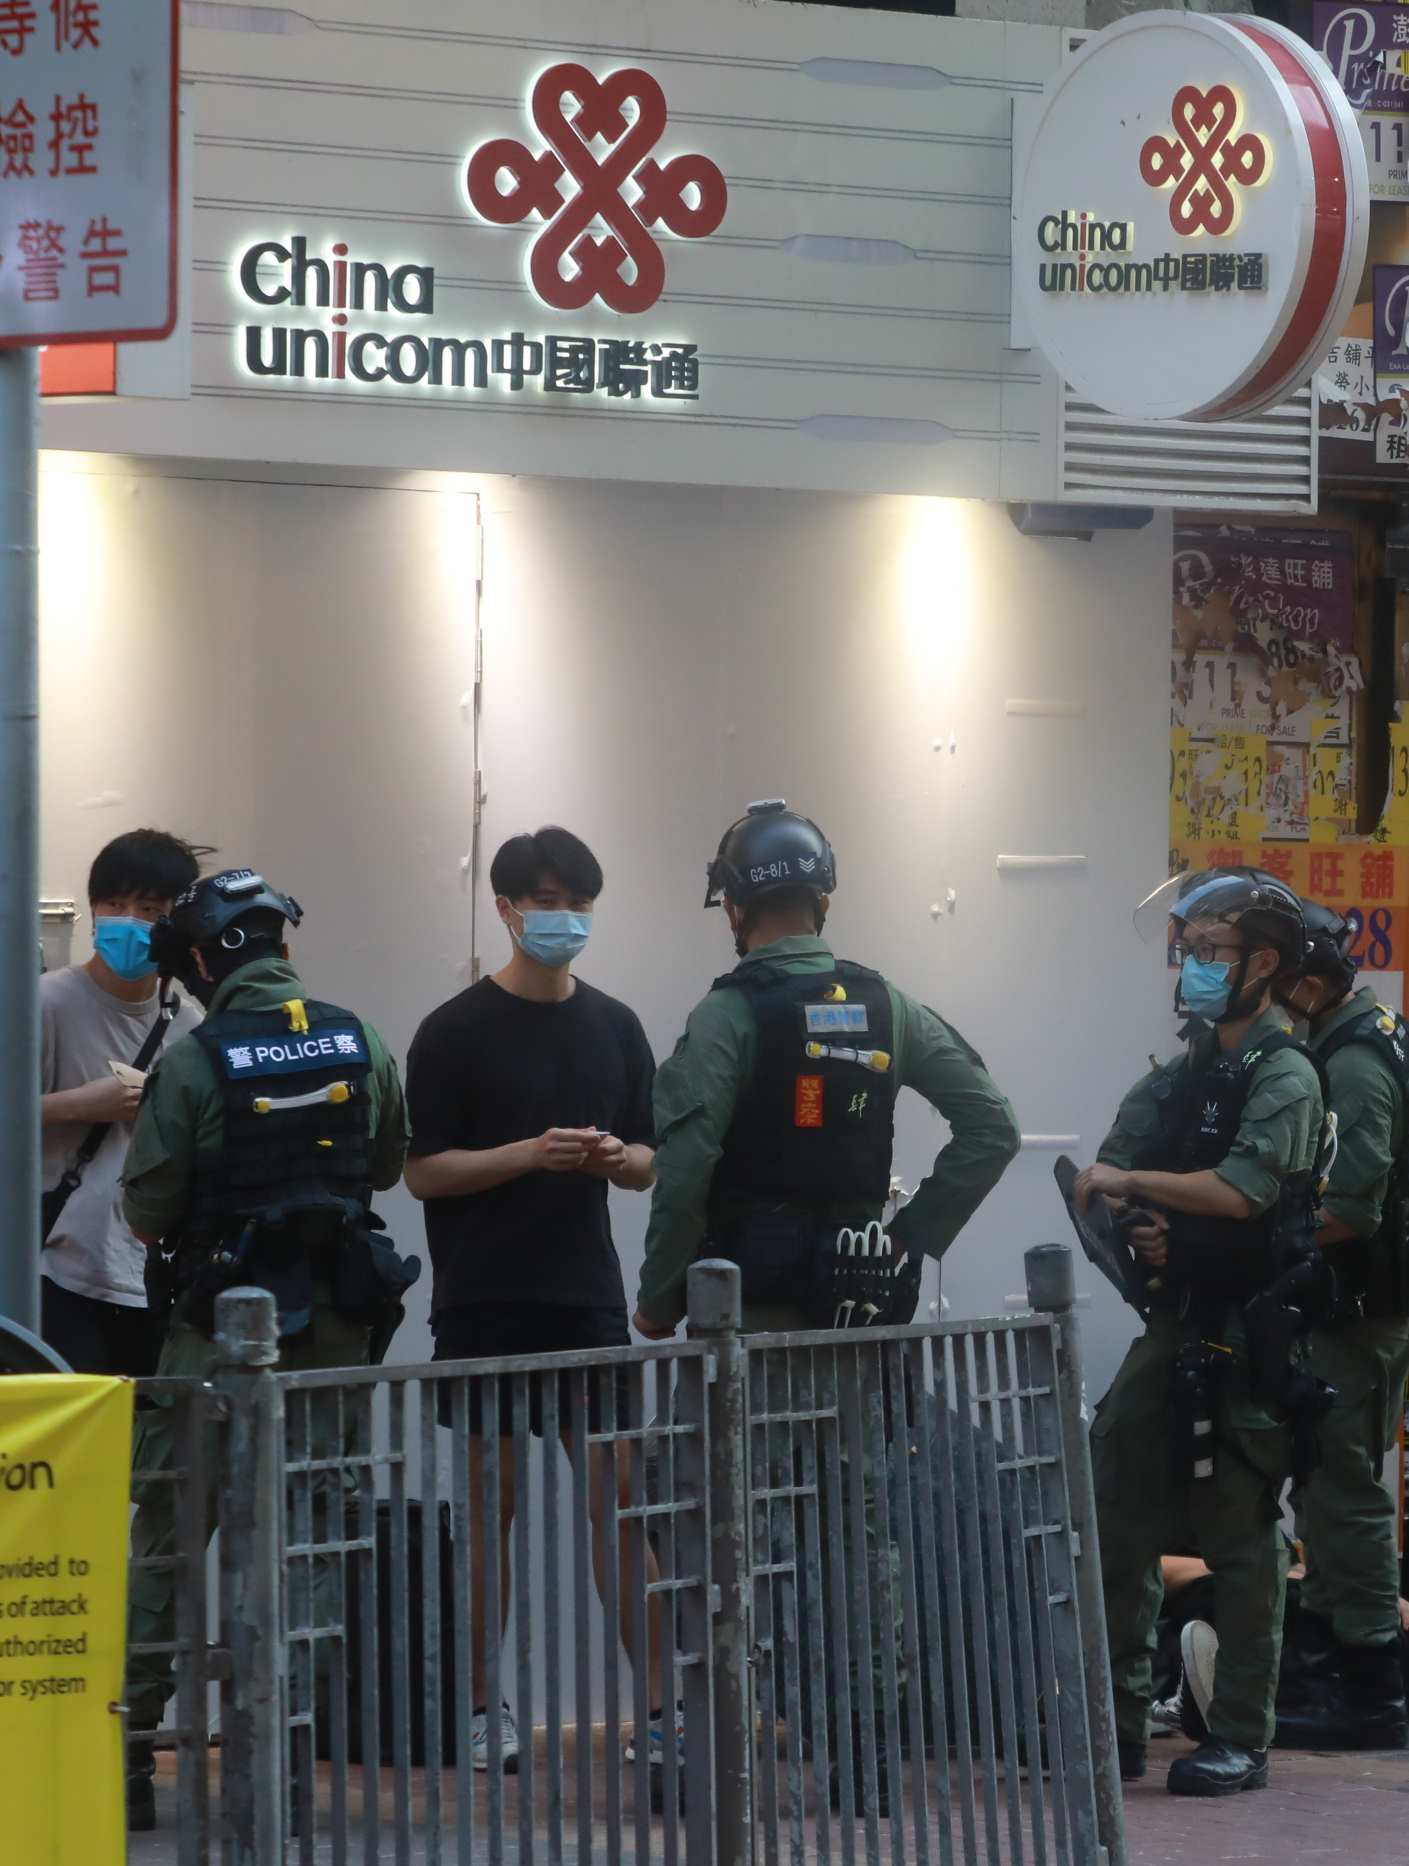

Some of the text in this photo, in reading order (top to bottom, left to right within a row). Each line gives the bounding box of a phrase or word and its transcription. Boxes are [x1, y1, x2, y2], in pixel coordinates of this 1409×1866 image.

[1037, 210, 1128, 252] China
[16, 215, 128, 302] 警告
[1039, 253, 1264, 292] unicom 中國聯通
[240, 236, 434, 314] China
[246, 312, 700, 400] unicom 中國聯通
[1386, 434, 1408, 459] 租
[1256, 724, 1296, 736] FOR SALE
[750, 860, 791, 883] G2-8/1
[227, 1034, 358, 1069] 警 POLICE 察
[69, 1557, 89, 1577] to
[7, 1593, 88, 1618] of attack
[20, 1676, 86, 1701] system
